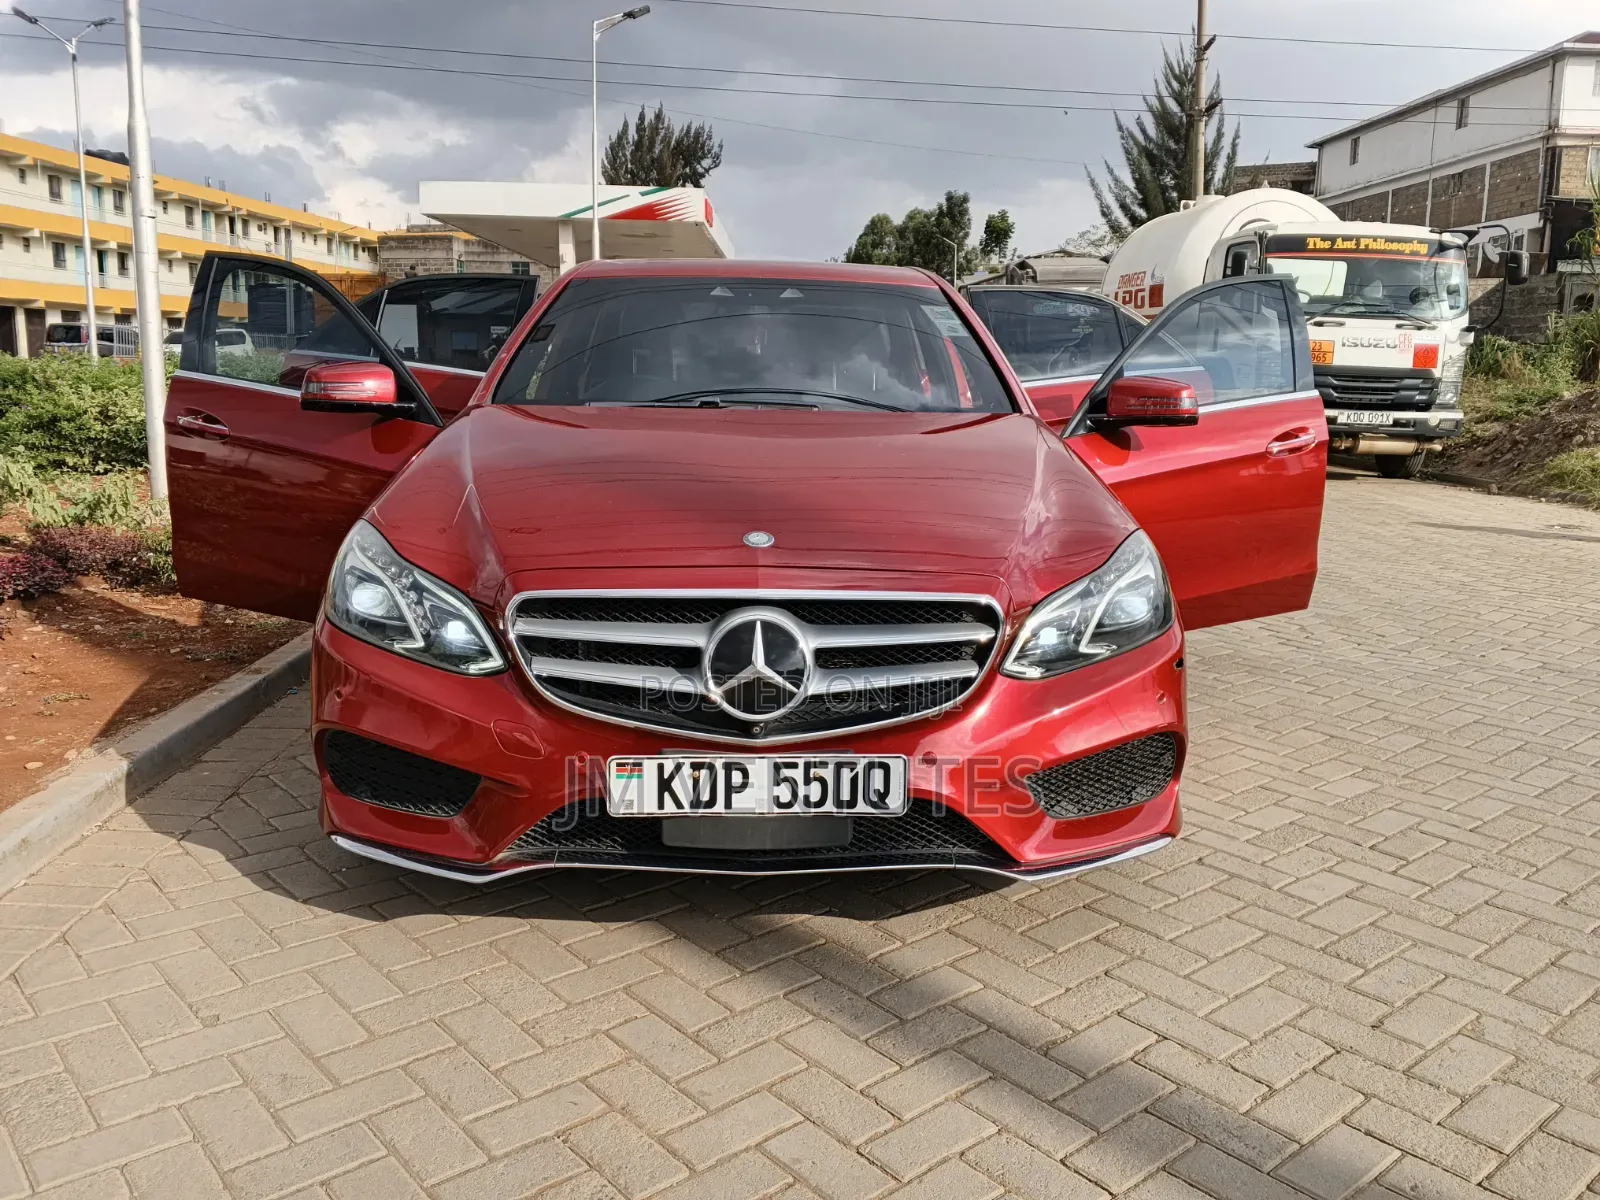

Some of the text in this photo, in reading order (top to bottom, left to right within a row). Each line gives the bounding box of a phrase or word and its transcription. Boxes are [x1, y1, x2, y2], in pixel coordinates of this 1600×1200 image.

[1306, 237, 1429, 254] The Ant Philosophy
[1117, 271, 1147, 289] DANGER
[1312, 341, 1323, 351] 23
[1341, 336, 1398, 349] ISUZU
[1311, 353, 1327, 363] 965
[1346, 411, 1391, 423] KDQ 091X
[657, 761, 750, 810] KDP
[773, 760, 891, 810] 550Q
